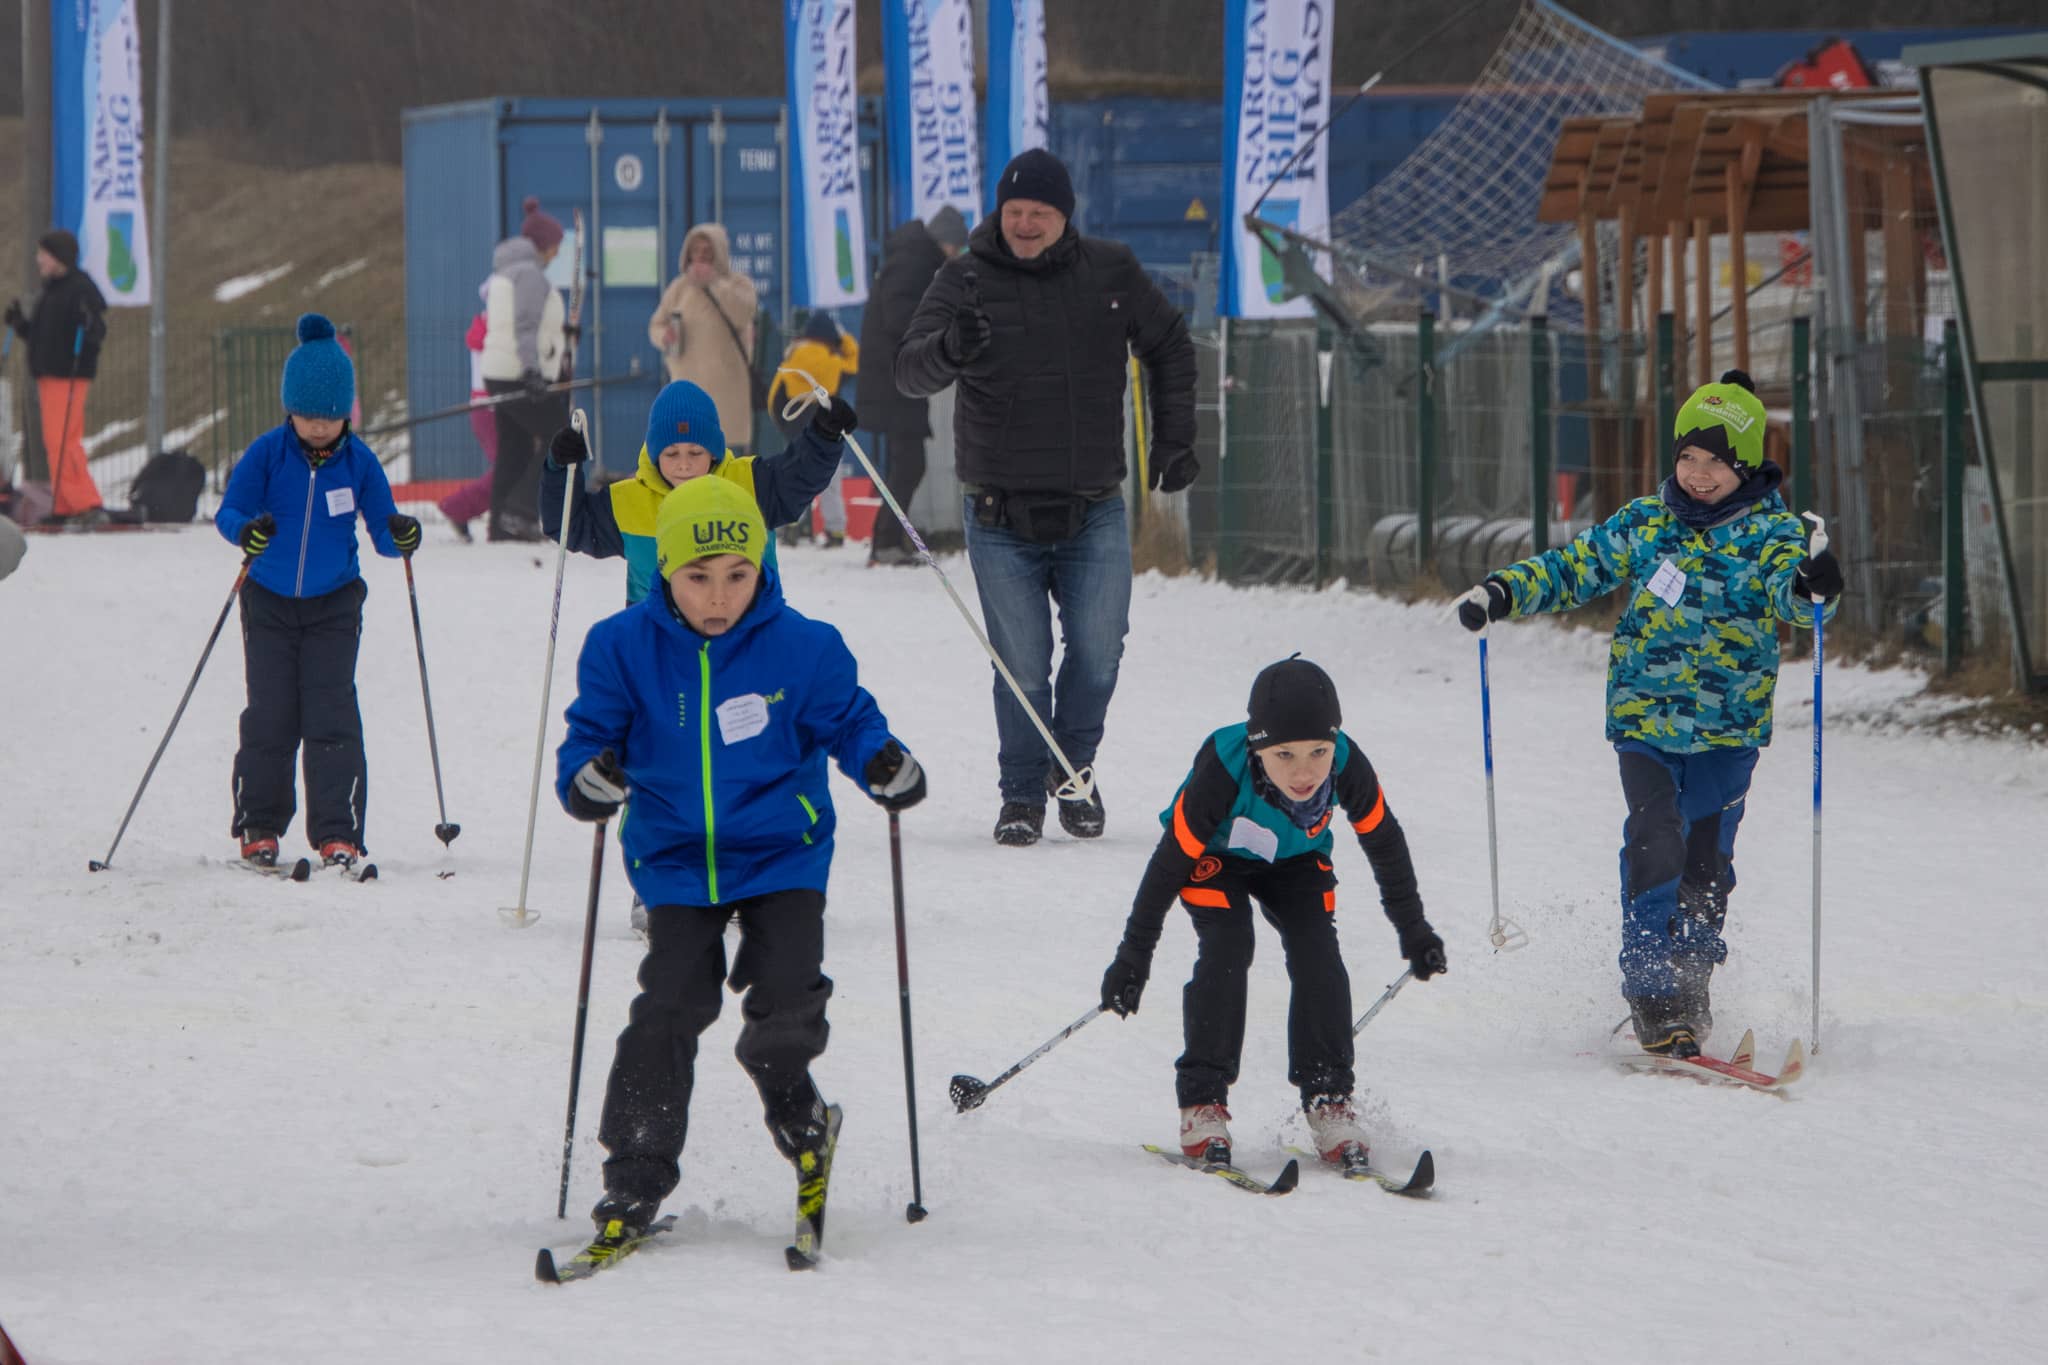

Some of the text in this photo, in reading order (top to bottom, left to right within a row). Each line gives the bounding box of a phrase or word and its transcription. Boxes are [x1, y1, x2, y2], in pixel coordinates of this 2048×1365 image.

[110, 94, 136, 199] BIEG
[938, 83, 970, 196] BIEG
[1245, 0, 1267, 185] NARCIA
[1267, 50, 1300, 182] BIEG
[693, 520, 750, 545] UKS
